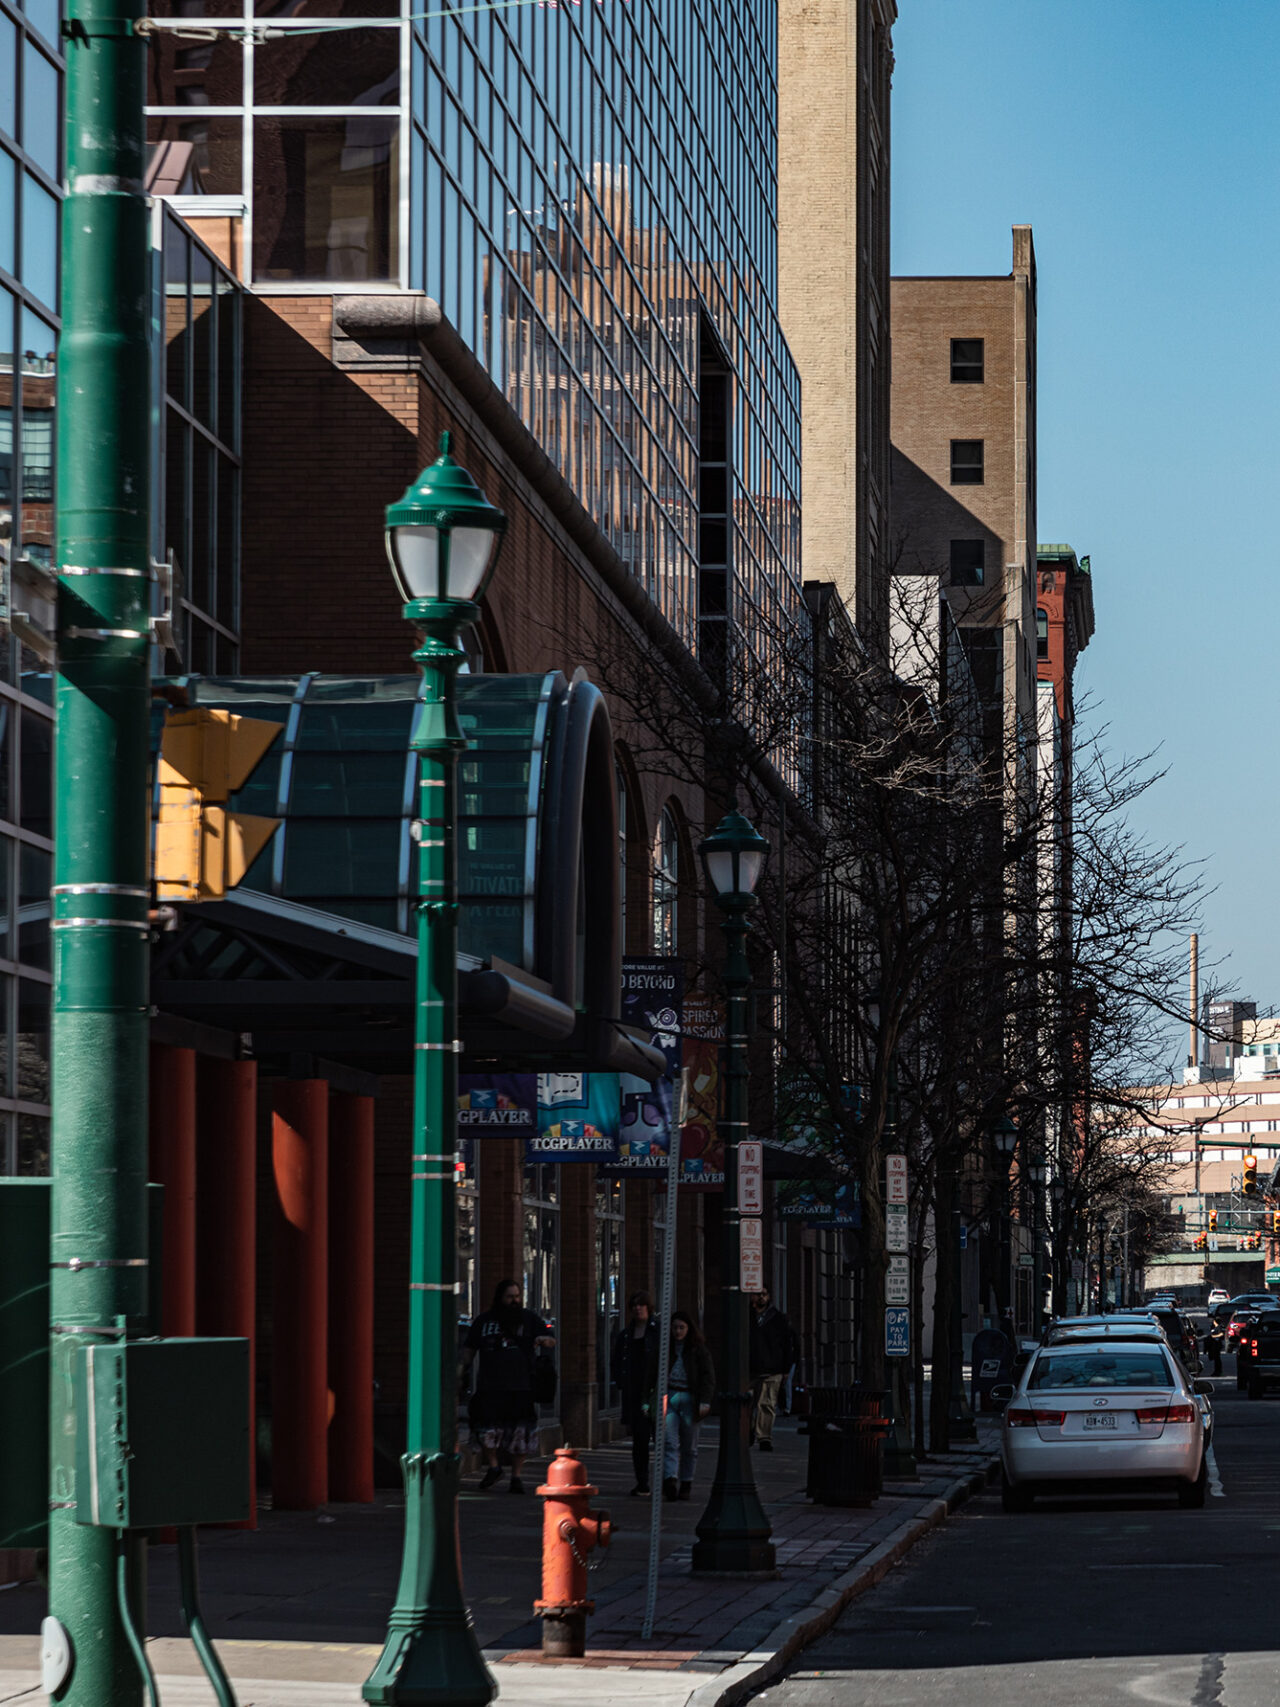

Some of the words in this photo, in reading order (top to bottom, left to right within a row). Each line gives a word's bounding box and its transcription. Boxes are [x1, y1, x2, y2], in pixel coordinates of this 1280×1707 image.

[629, 975, 676, 990] BEYOND
[457, 1110, 532, 1124] GPLAYER
[532, 1137, 616, 1151] TCGPLAYER
[745, 1149, 755, 1162] NO
[893, 1159, 902, 1169] NO
